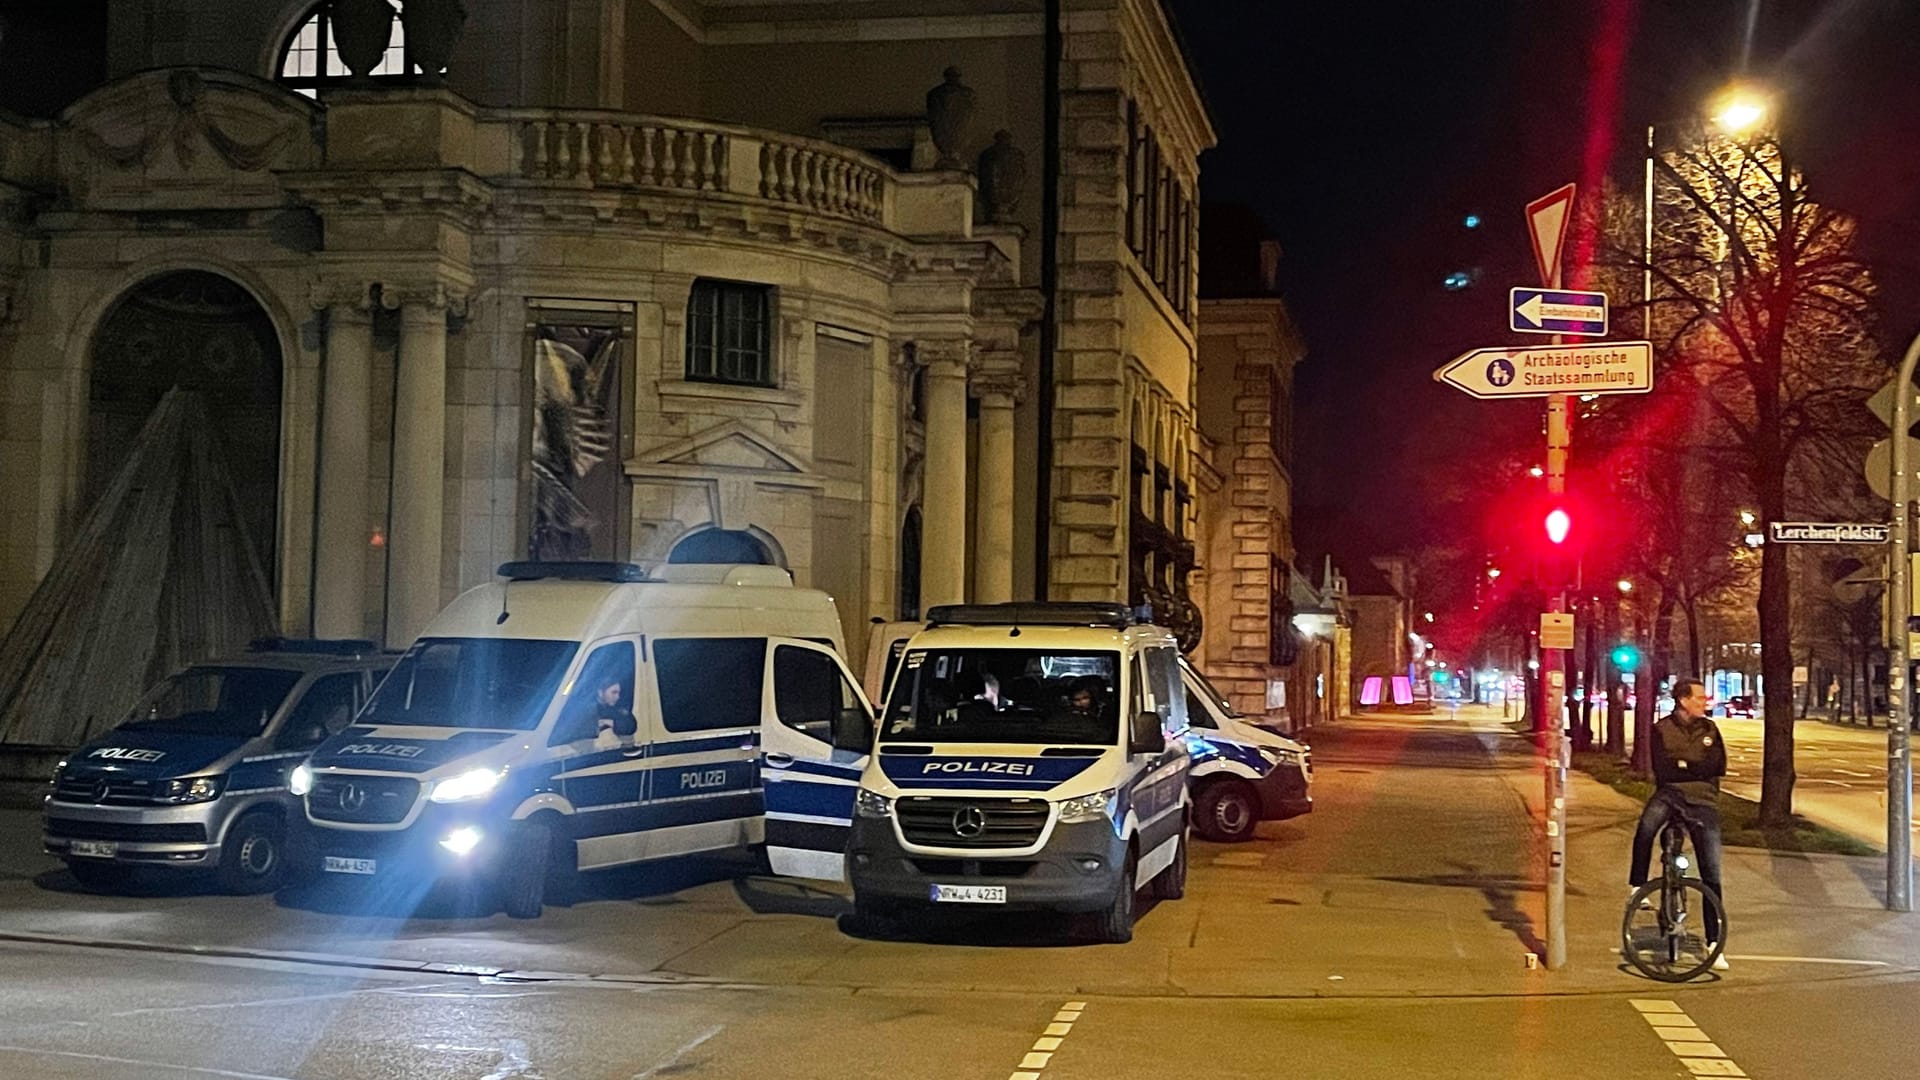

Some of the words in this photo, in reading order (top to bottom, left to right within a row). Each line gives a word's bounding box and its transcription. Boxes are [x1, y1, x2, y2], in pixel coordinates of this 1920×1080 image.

[1523, 350, 1628, 369] Archäologische
[1524, 369, 1635, 386] Staatssammlung
[87, 747, 167, 763] POLIZEI
[337, 743, 425, 758] POLIZEI
[922, 761, 1035, 776] POLIZEI
[680, 769, 727, 790] POLIZEI
